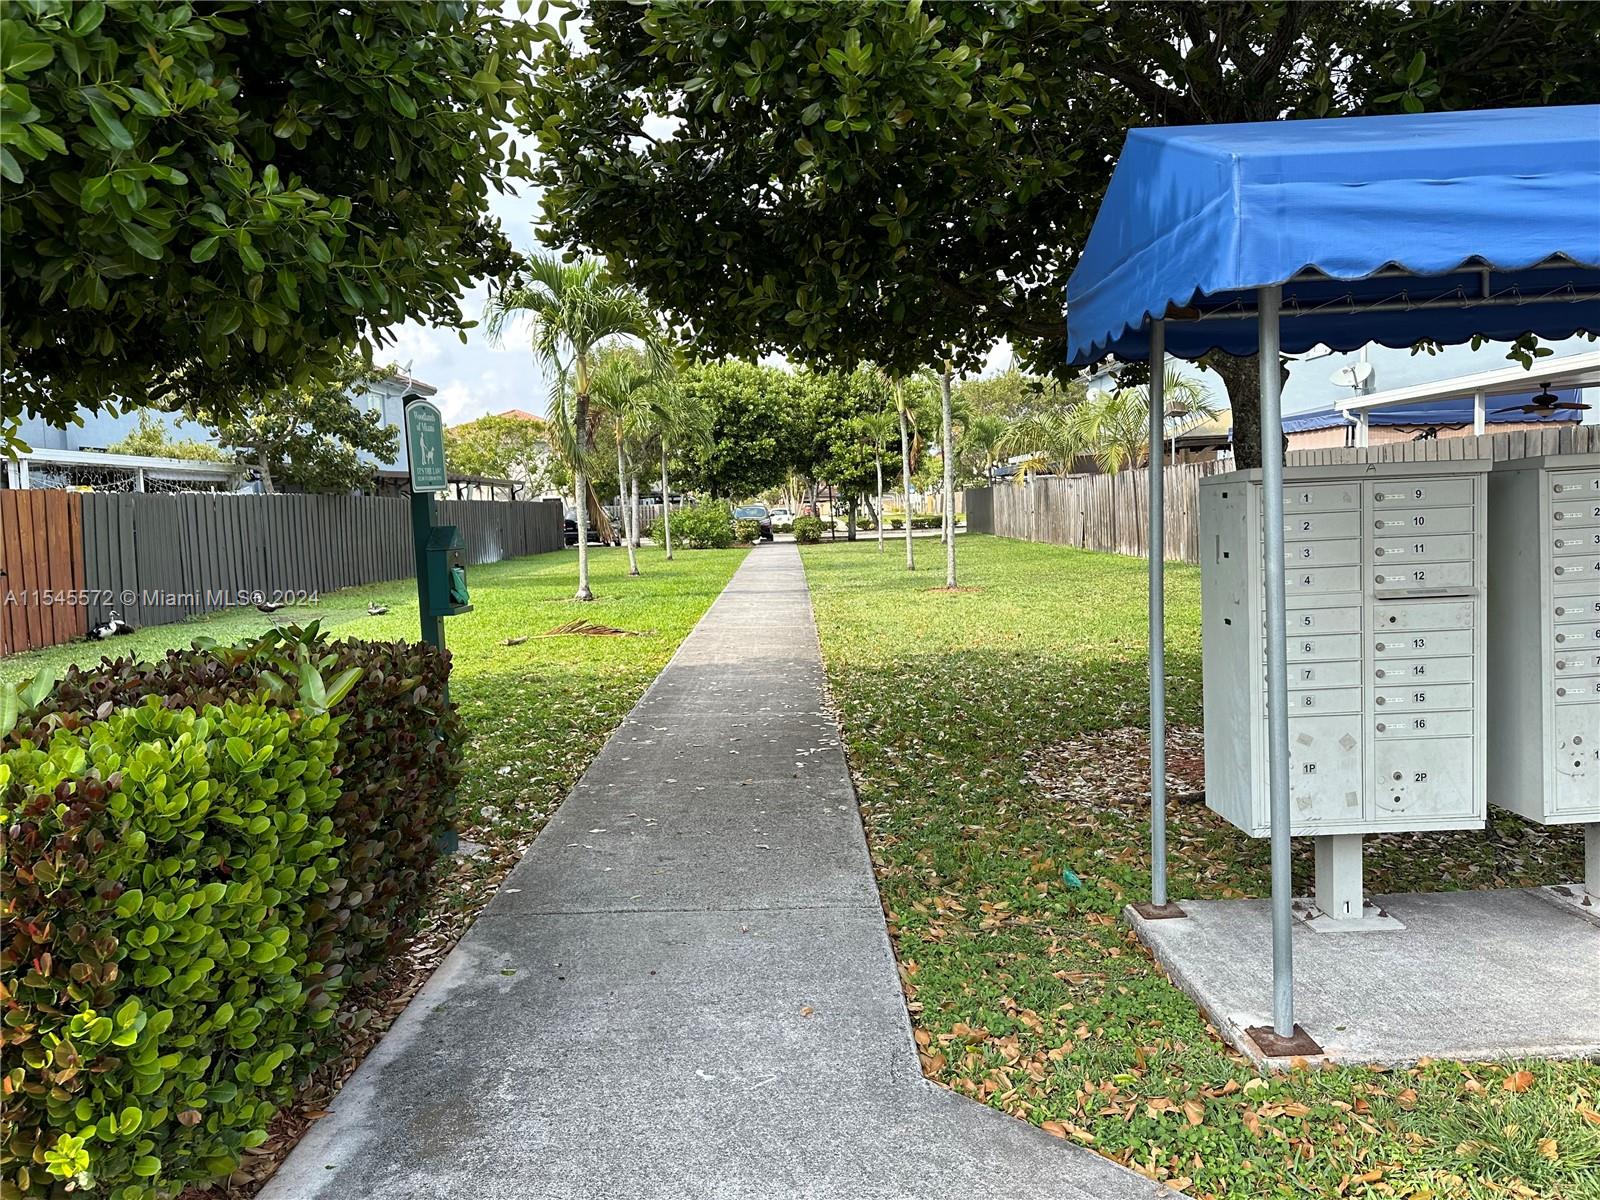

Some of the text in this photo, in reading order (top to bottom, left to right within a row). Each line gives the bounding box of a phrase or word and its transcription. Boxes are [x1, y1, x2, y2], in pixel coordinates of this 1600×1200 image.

[1365, 463, 1376, 473] A
[1594, 480, 1599, 488] 1
[1304, 494, 1309, 502] 1
[1415, 490, 1422, 498] 9
[1594, 508, 1600, 516] 2
[1414, 517, 1424, 525] 10
[1304, 522, 1310, 530] 2
[1594, 535, 1600, 543] 3
[1414, 544, 1424, 552] 11
[1304, 549, 1310, 557] 3
[1594, 562, 1600, 571] 4
[1304, 576, 1310, 584] 4
[1414, 572, 1425, 580] 12
[1595, 603, 1600, 611] 5
[1305, 617, 1310, 625] 5
[1414, 639, 1424, 648] 13
[1305, 644, 1311, 652] 6
[1305, 671, 1311, 679] 7
[1306, 697, 1312, 705] 8
[1414, 693, 1425, 702] 15
[1414, 720, 1425, 728] 16
[1303, 764, 1316, 772] 1P
[1415, 773, 1427, 782] 2P
